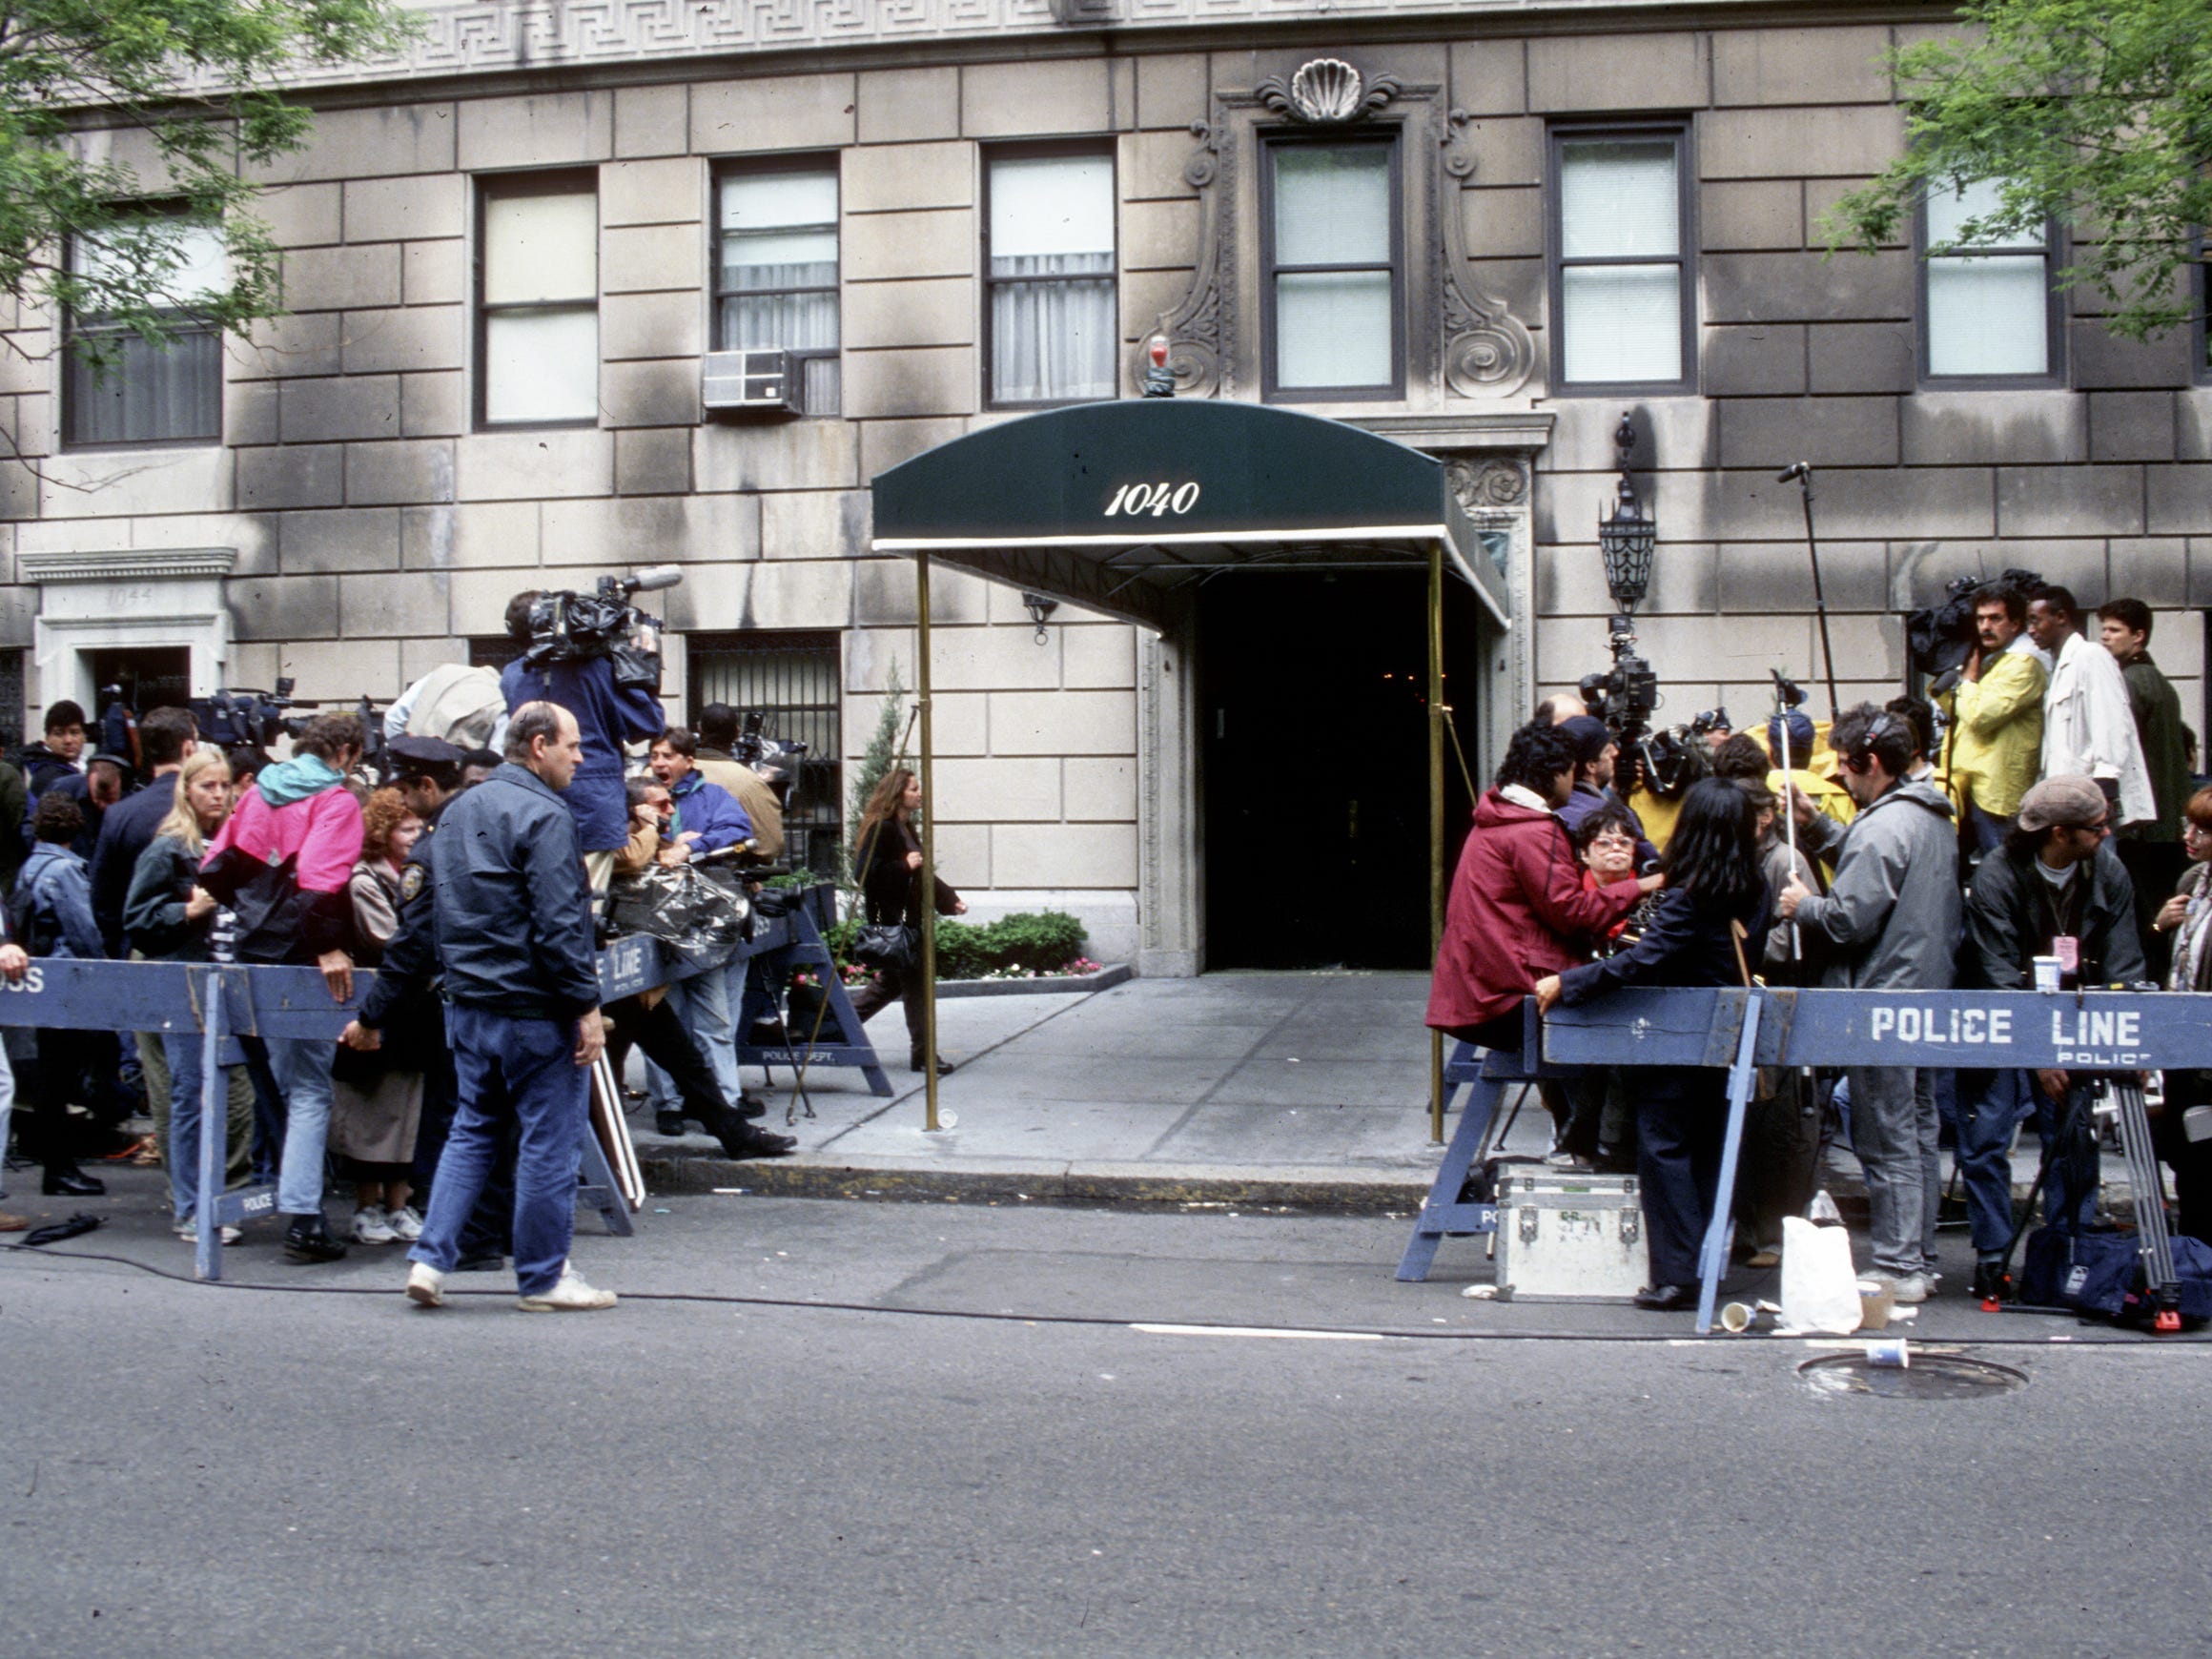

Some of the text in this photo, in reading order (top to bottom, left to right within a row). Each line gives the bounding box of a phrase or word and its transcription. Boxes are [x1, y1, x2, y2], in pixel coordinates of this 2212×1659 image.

[1104, 481, 1200, 516] 1040
[613, 947, 642, 980] LINE
[1872, 1008, 2140, 1046] POLICE LINE
[243, 1193, 273, 1212] POLICE
